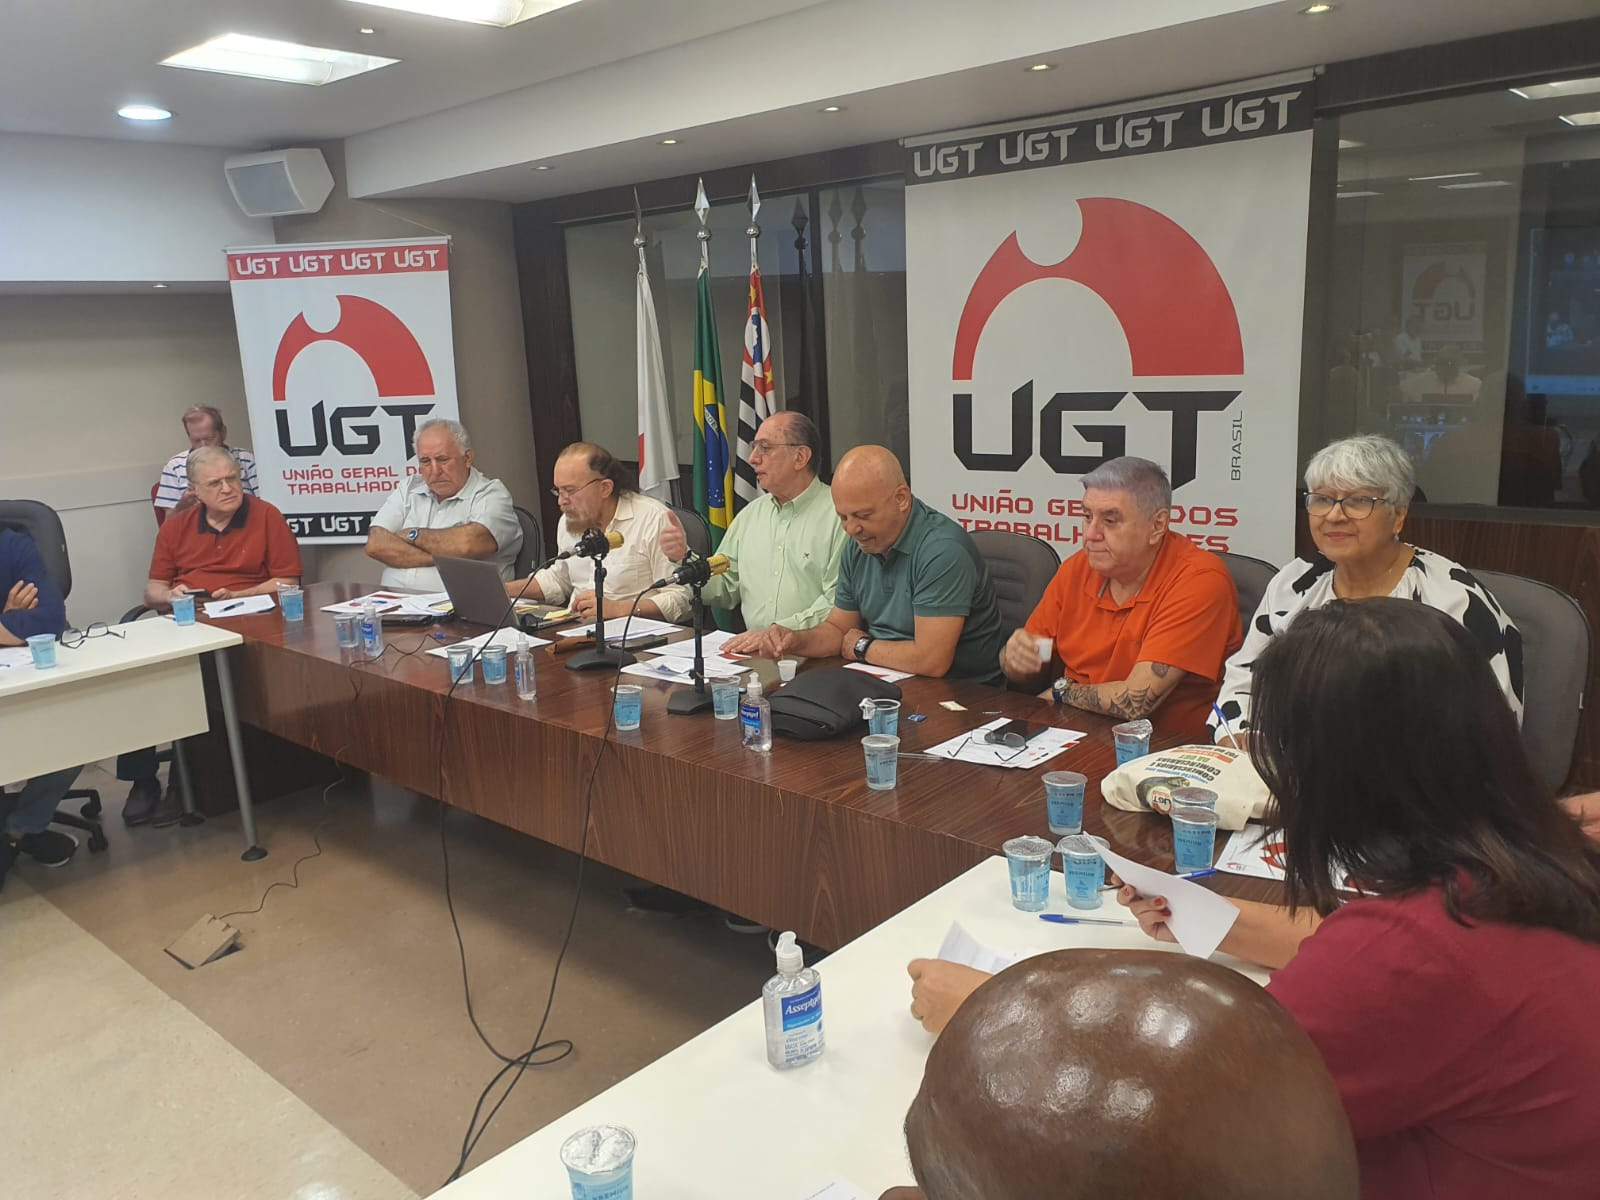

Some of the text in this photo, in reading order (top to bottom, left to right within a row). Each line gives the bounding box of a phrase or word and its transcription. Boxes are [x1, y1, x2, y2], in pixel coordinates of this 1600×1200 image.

[914, 91, 1302, 177] UGT UGT UGT UGT
[236, 248, 440, 276] UGT UGT UGT UGT
[275, 400, 436, 461] UGT
[952, 379, 1243, 492] UGT
[1230, 410, 1244, 481] BRASIL
[282, 464, 334, 481] UNIÃO
[341, 466, 399, 479] GERAL
[288, 480, 400, 496] TRABALHAD
[952, 489, 1034, 515] UNIÃO
[286, 517, 314, 535] GT
[321, 515, 364, 534] UGT
